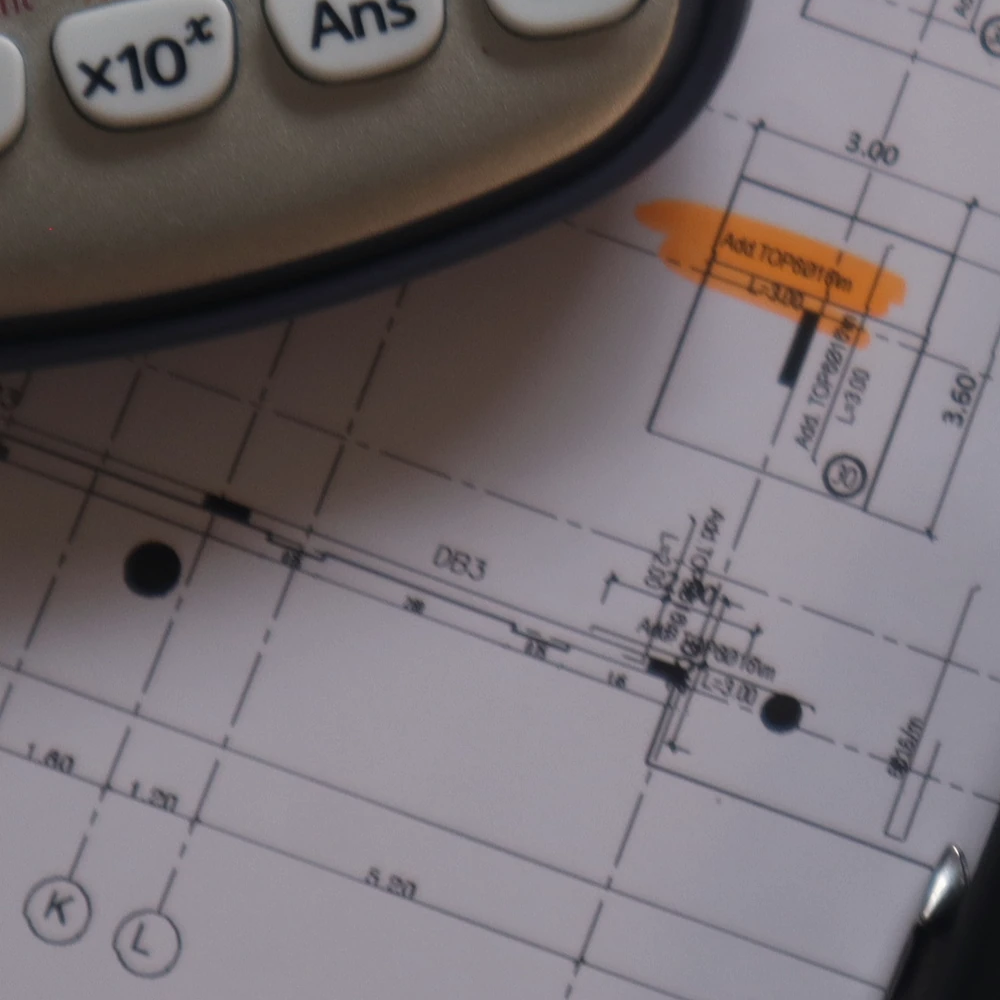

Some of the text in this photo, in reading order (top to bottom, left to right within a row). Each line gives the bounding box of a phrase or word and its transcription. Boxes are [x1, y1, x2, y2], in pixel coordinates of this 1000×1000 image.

[844, 129, 900, 167] 3.00
[431, 543, 488, 581] DB3
[44, 889, 74, 926] K
[131, 922, 151, 957] L
